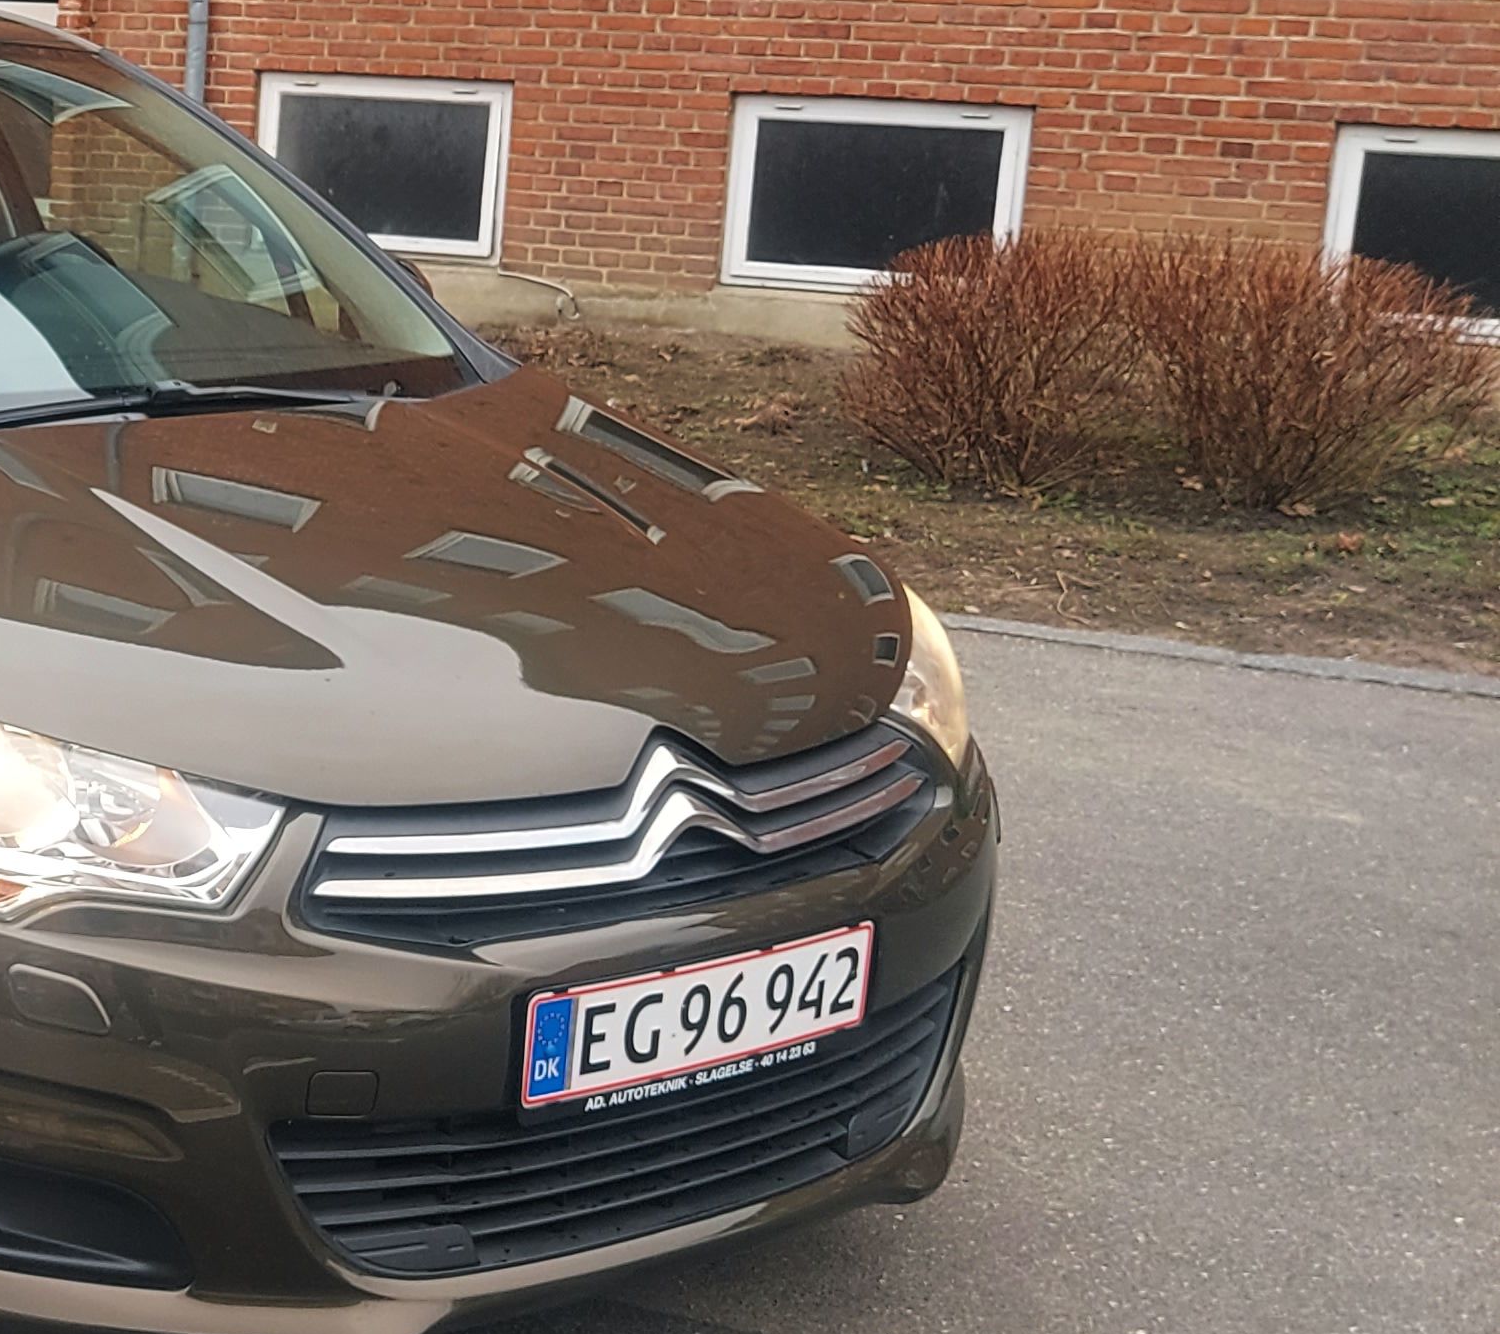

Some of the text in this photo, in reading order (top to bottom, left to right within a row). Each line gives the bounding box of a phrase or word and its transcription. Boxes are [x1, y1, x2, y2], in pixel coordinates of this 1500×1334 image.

[579, 946, 860, 1075] EG 96 942
[534, 1056, 560, 1081] DK
[608, 1076, 688, 1106] AUTOTEKNIK
[694, 1058, 755, 1085] SLAGELSE
[760, 1053, 775, 1067] 40
[776, 1049, 788, 1063] 14
[788, 1045, 802, 1060] 23
